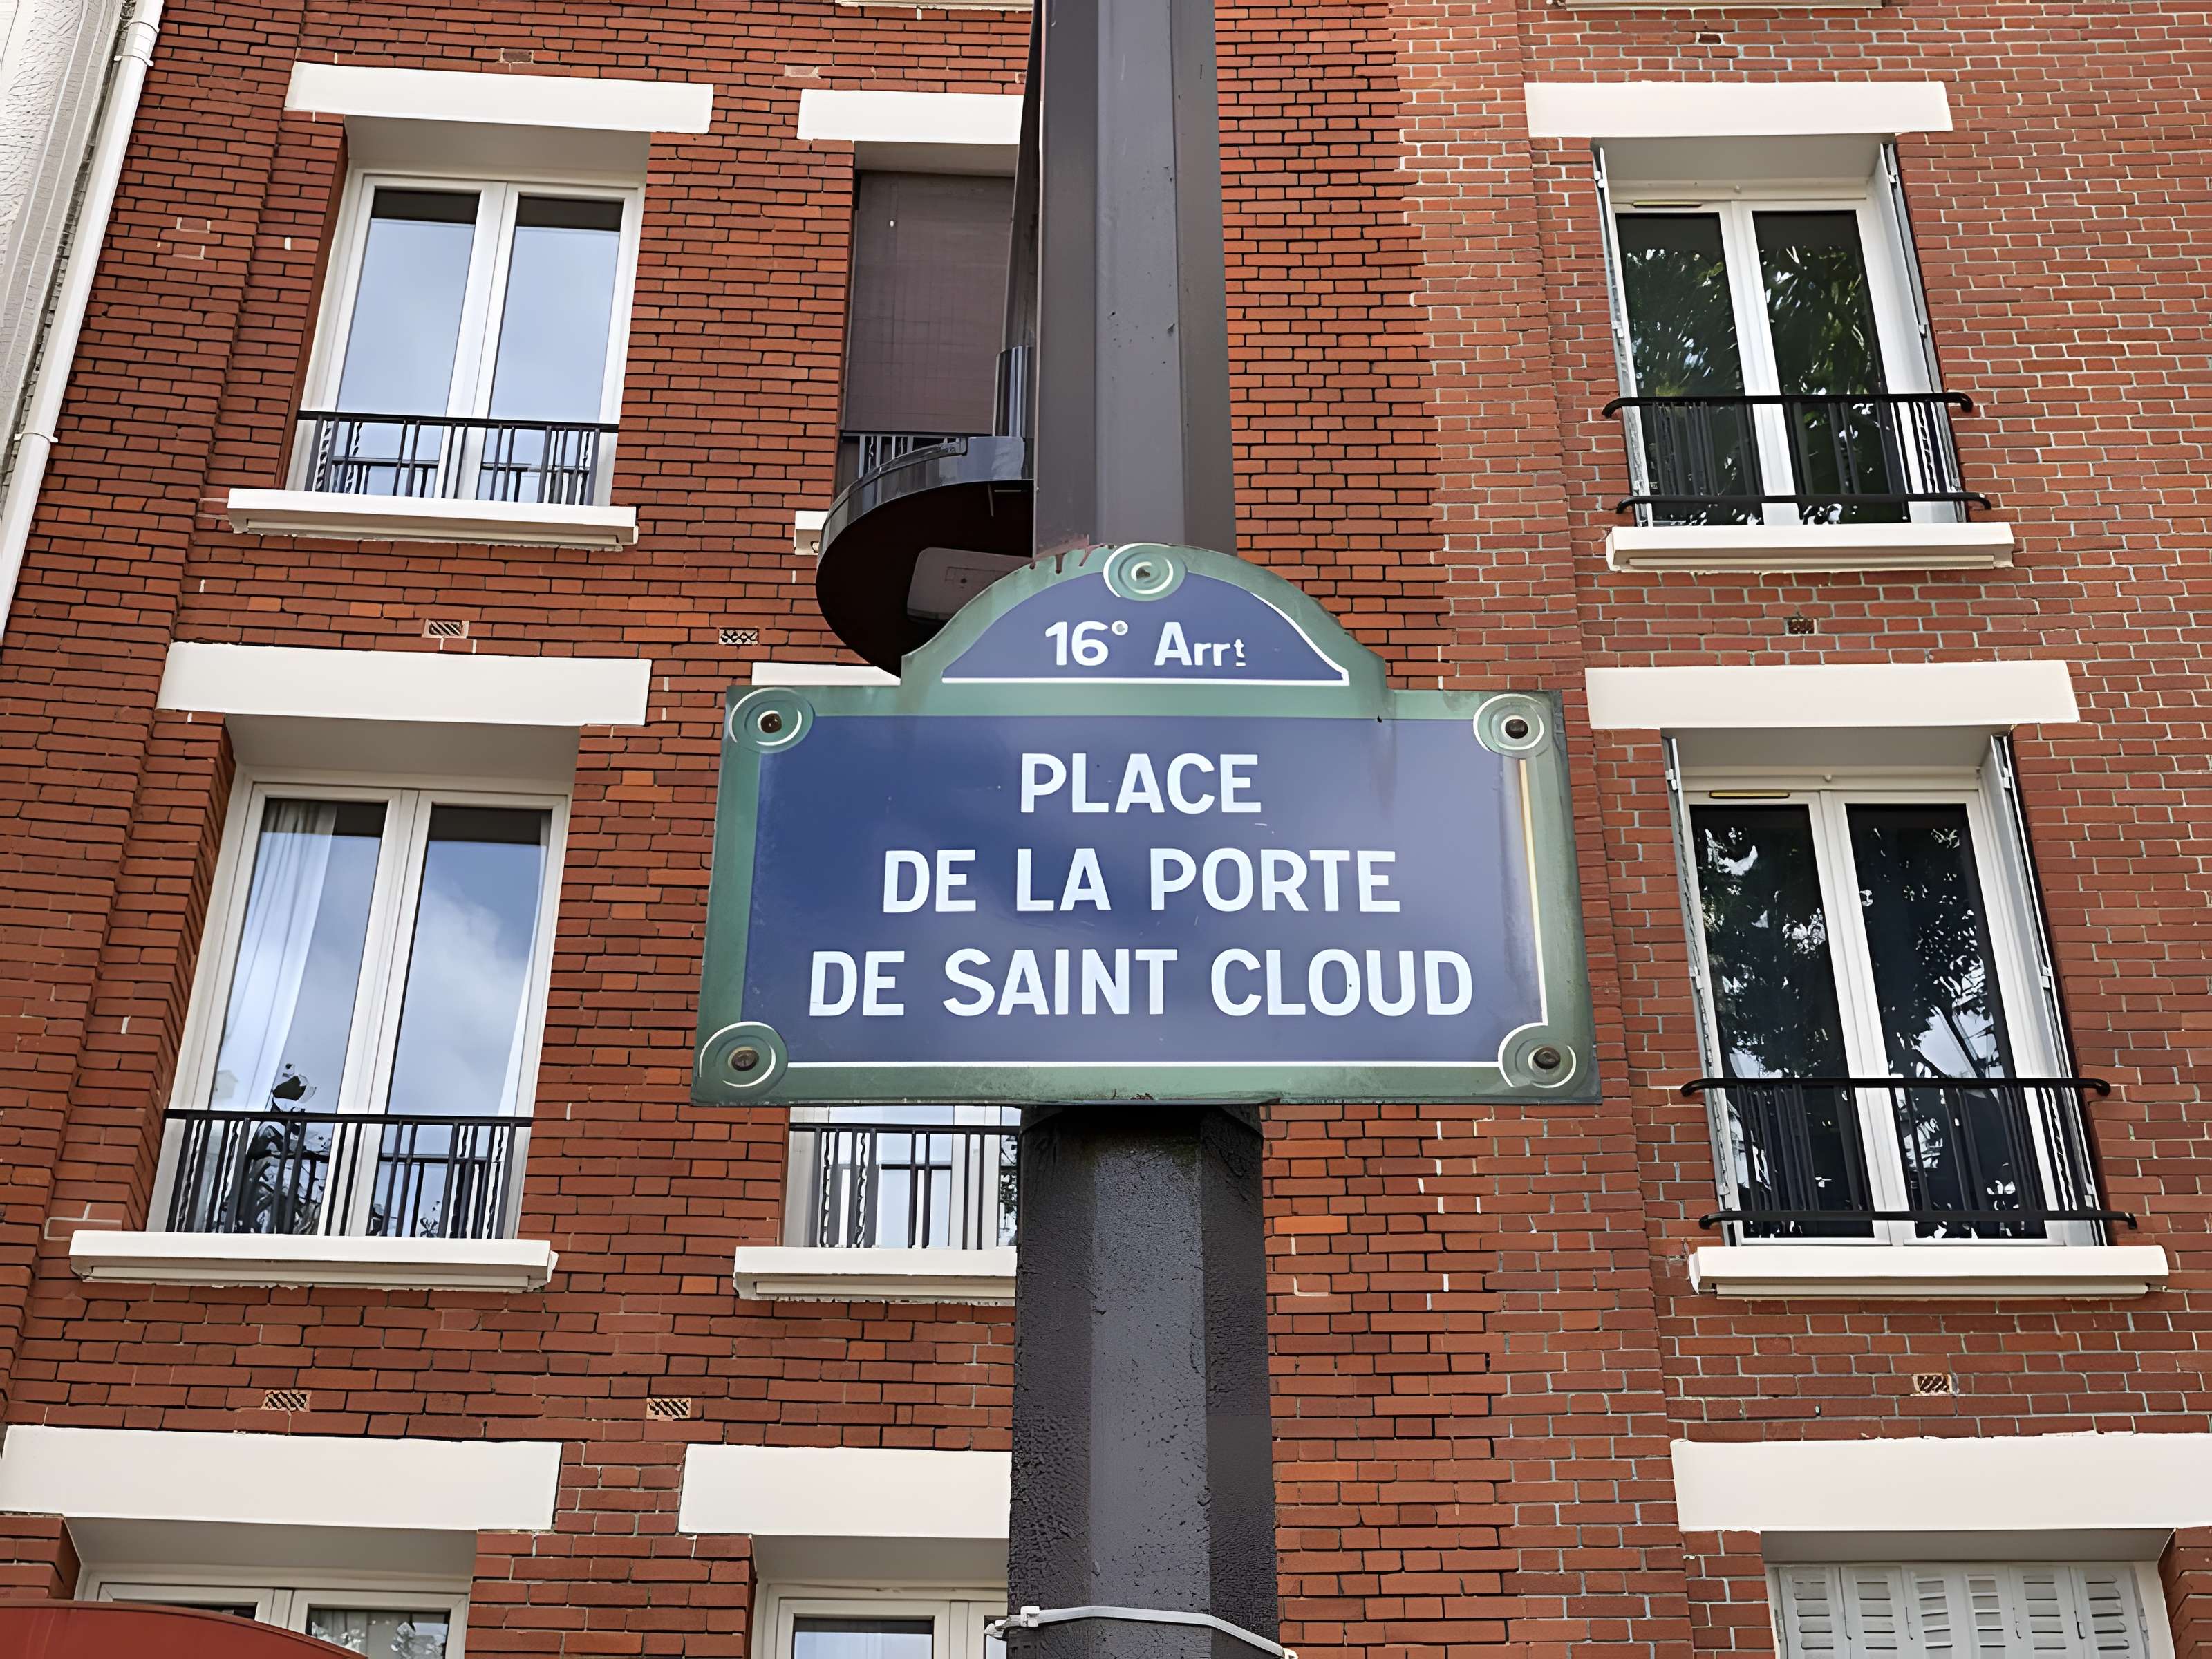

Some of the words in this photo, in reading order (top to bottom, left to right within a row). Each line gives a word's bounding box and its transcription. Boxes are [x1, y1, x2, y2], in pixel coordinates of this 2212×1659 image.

[1019, 752, 1262, 815] PLACE
[882, 850, 977, 914] DE
[1015, 847, 1112, 912] LA
[1149, 847, 1401, 913] PORTE
[808, 950, 906, 1018] DE
[942, 948, 1179, 1018] SAINT
[1210, 948, 1474, 1018] CLOUD
